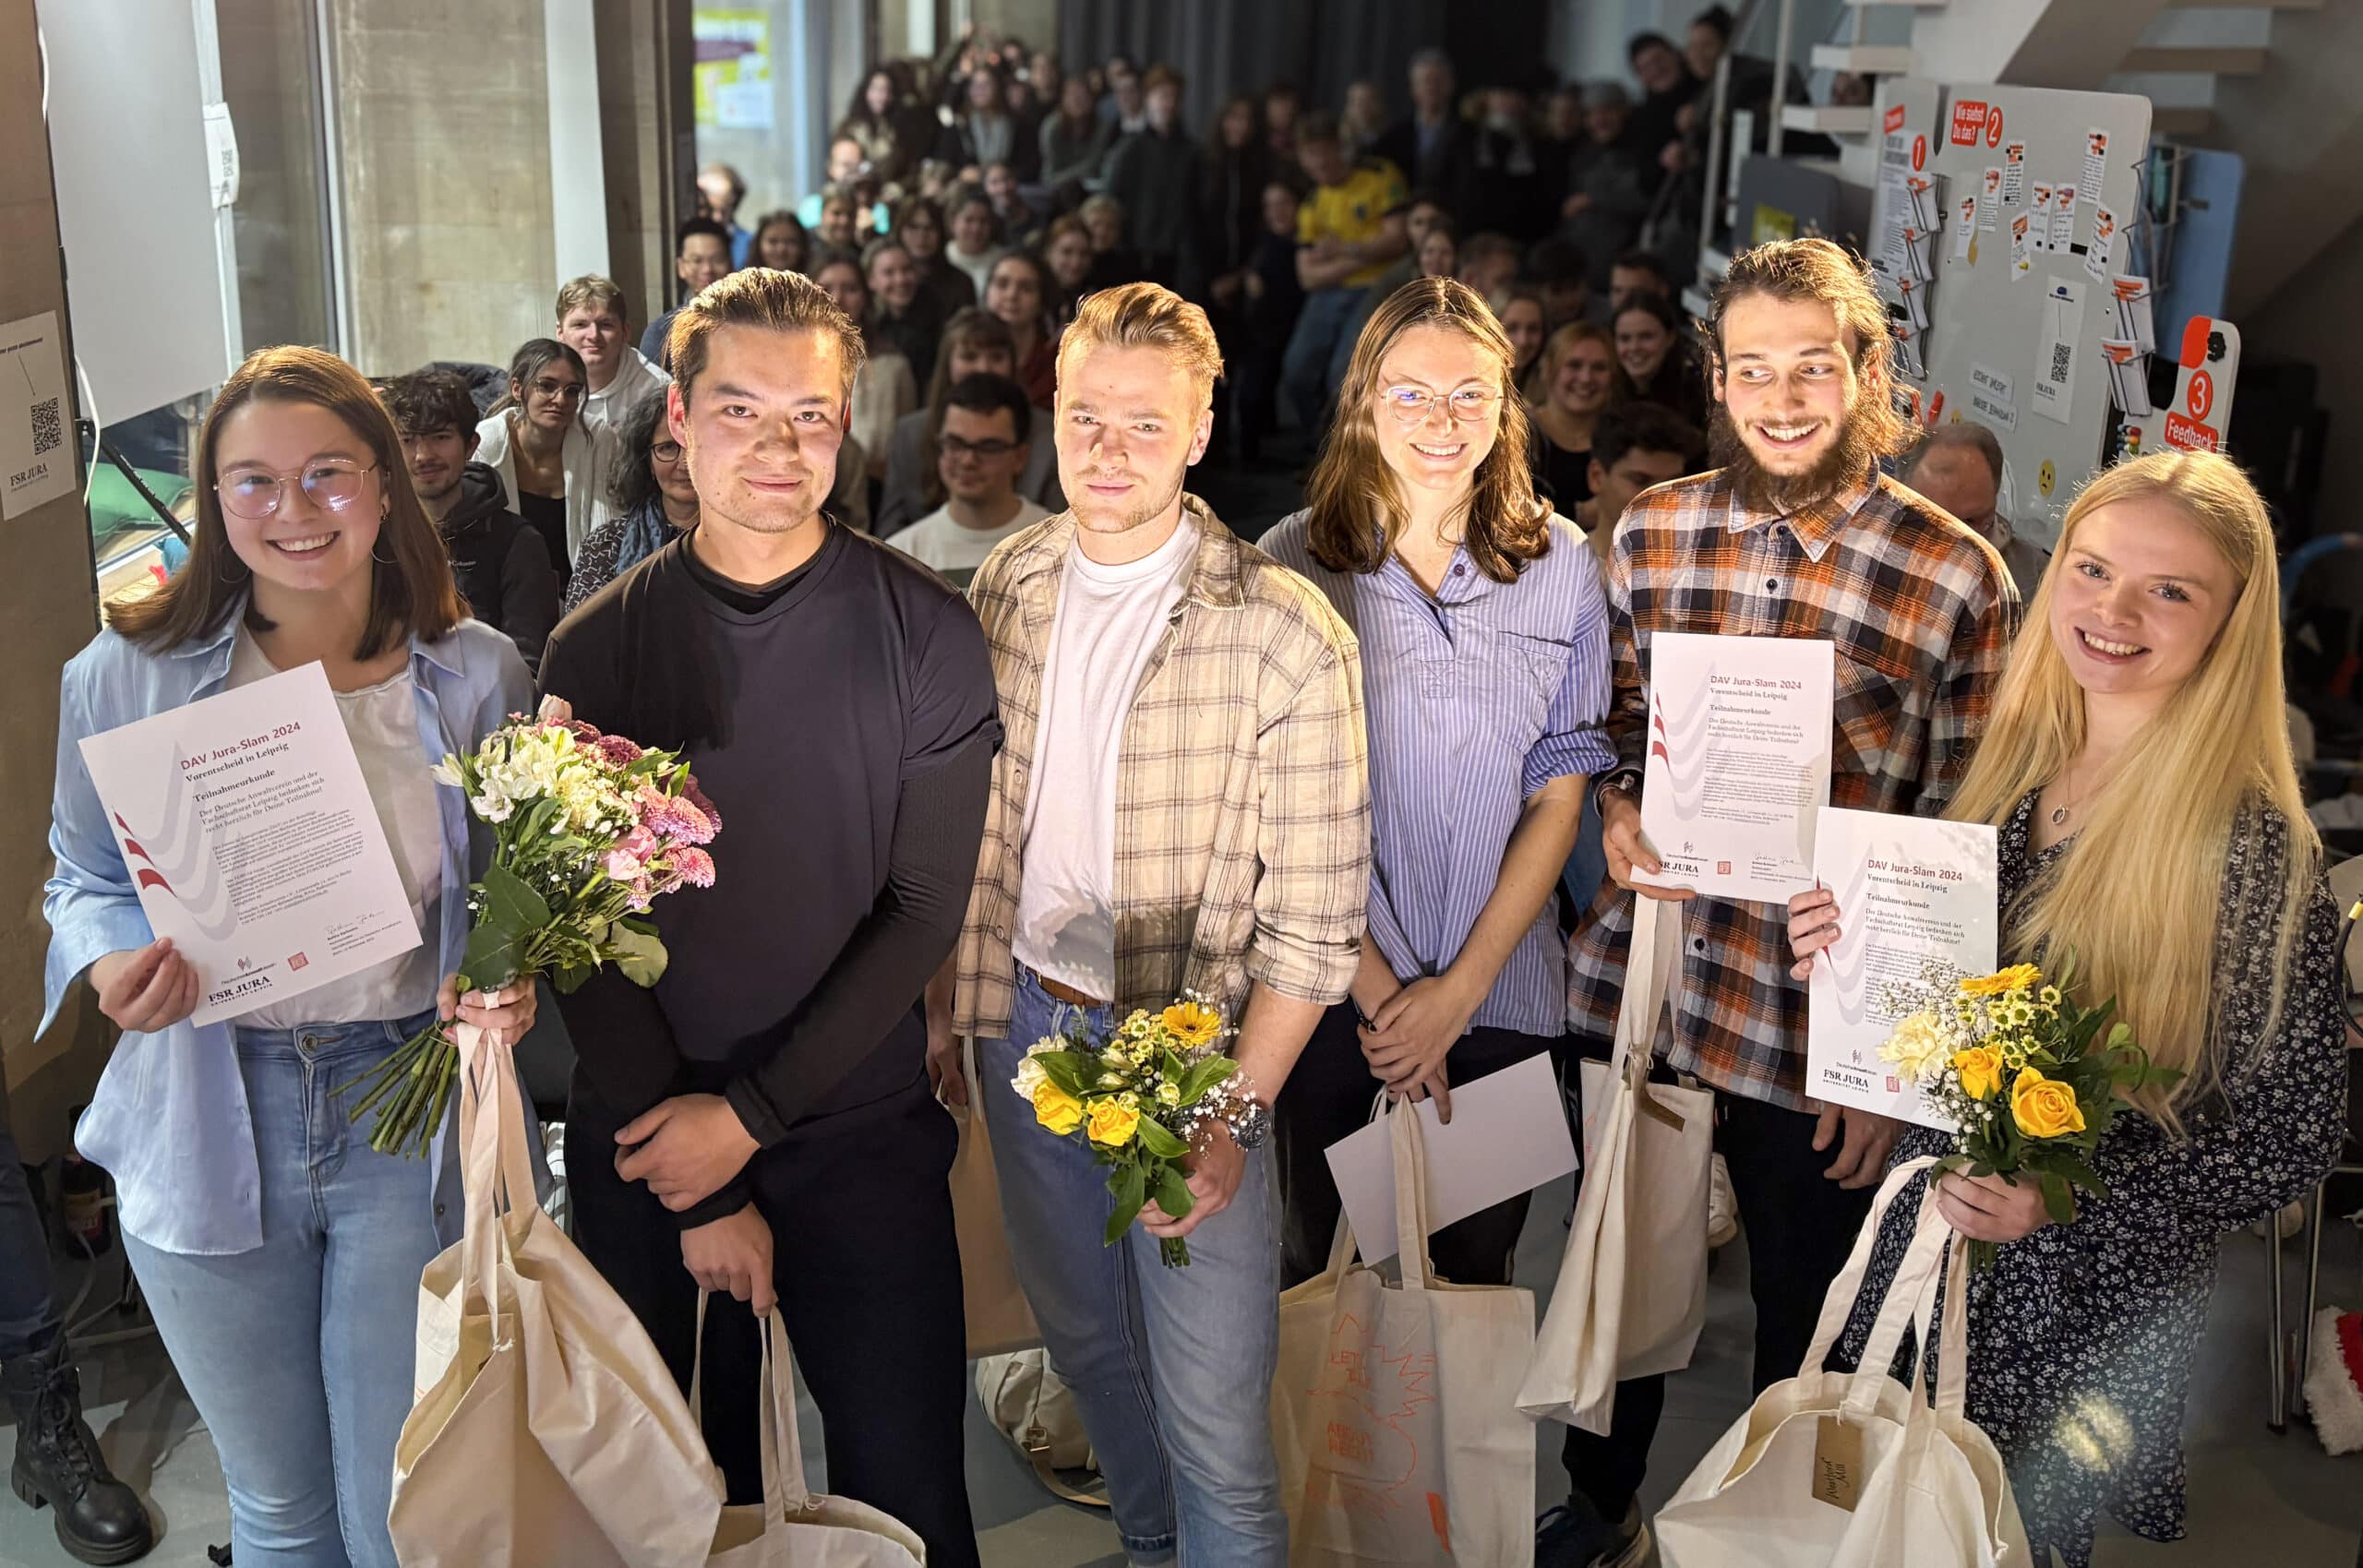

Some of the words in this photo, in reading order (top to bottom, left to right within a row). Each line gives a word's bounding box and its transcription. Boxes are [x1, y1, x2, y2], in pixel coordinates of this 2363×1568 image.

[1988, 111, 2000, 143] 2
[1915, 138, 1922, 167] 1
[2191, 376, 2207, 414] 3
[2167, 418, 2213, 450] Feedback
[9, 472, 27, 487] FSR
[27, 462, 48, 481] JURA
[1710, 676, 1731, 685] DAV
[1733, 676, 1777, 688] Jura-Slam
[1780, 679, 1802, 689] 2024
[1763, 691, 1788, 700] Leipzig
[180, 753, 208, 771] DAV
[211, 734, 270, 760] Jura-Slam
[271, 722, 301, 739] 2024
[185, 758, 244, 783] Vorentscheid
[246, 753, 255, 763] in
[256, 743, 289, 760] Leipzig
[192, 769, 275, 803] Teilnahmeurkunde
[1671, 862, 1699, 873] JURA
[1867, 859, 1888, 870] DAV
[1890, 863, 1936, 878] Jura-Slam
[1938, 869, 1962, 880] 2024
[1867, 873, 1911, 887] Vorentscheid
[1921, 881, 1948, 893] Leipzig
[1866, 892, 1930, 909] Teilnahmeurkunde
[208, 985, 234, 1003] FSR
[235, 976, 270, 994] JURA
[1823, 1069, 1841, 1081] FSR
[1843, 1073, 1869, 1088] JURA
